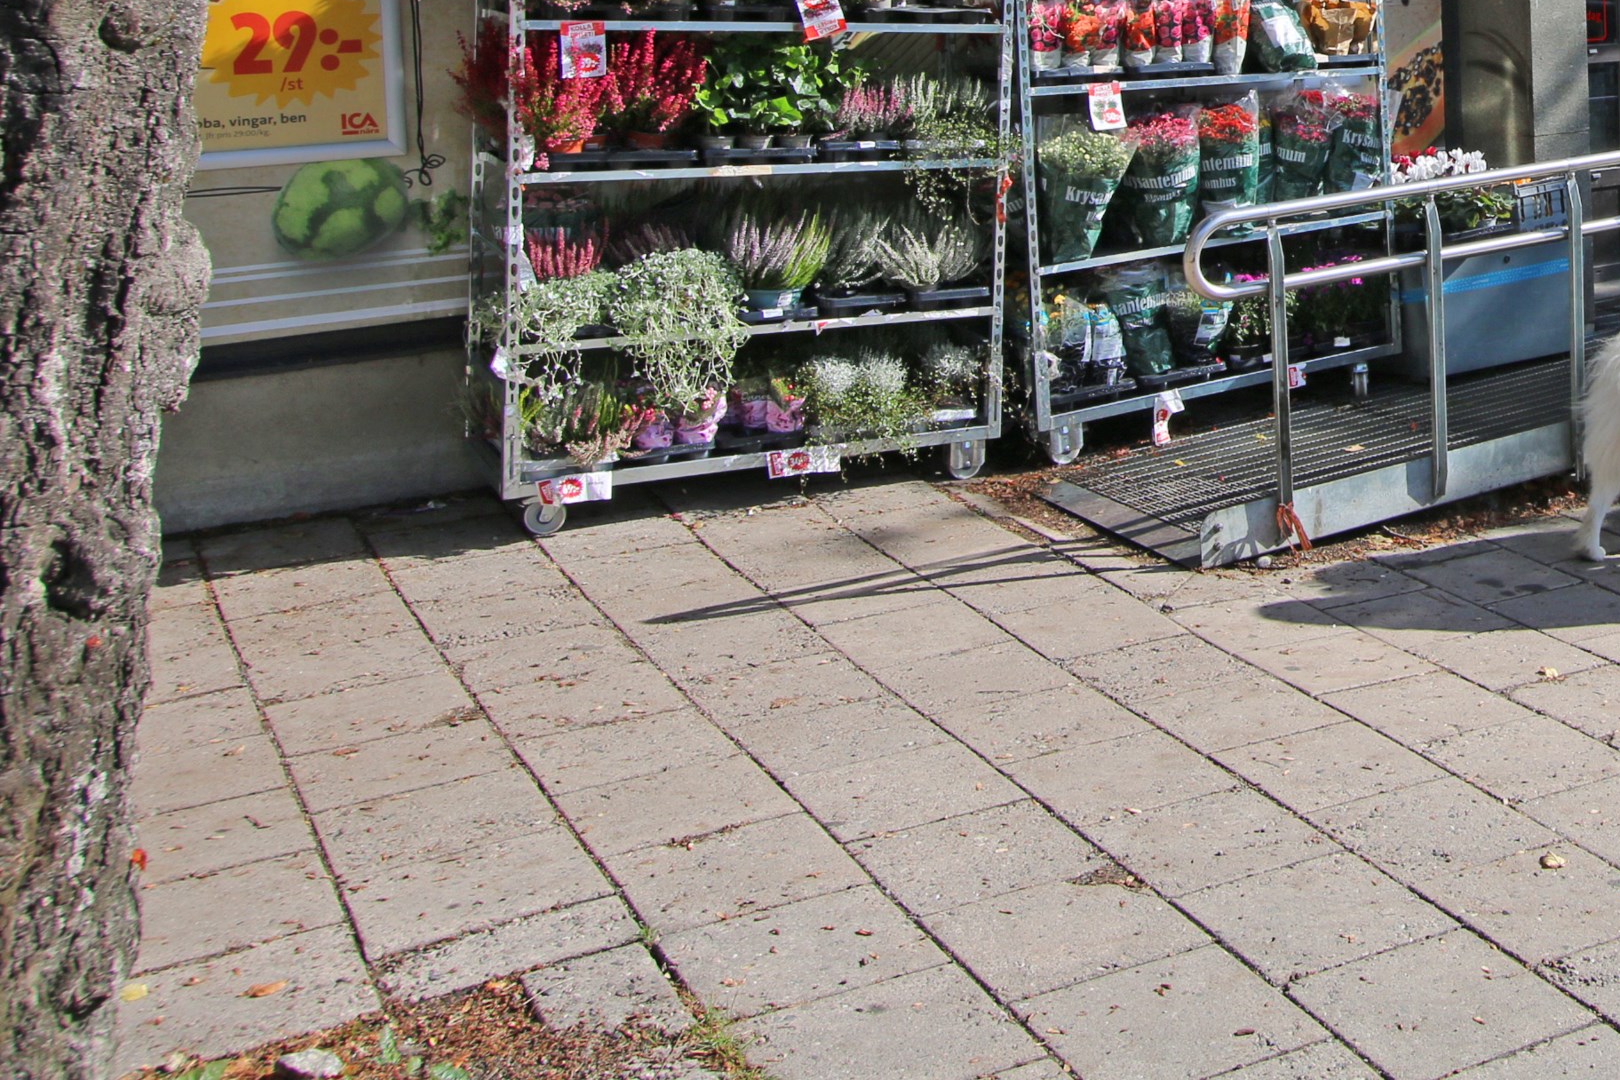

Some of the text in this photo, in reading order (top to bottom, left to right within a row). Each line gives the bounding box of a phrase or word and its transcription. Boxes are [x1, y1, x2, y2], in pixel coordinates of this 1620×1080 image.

[280, 77, 304, 92] /st
[229, 116, 277, 129] vingar,
[280, 113, 307, 124] ben
[341, 112, 378, 129] ICA
